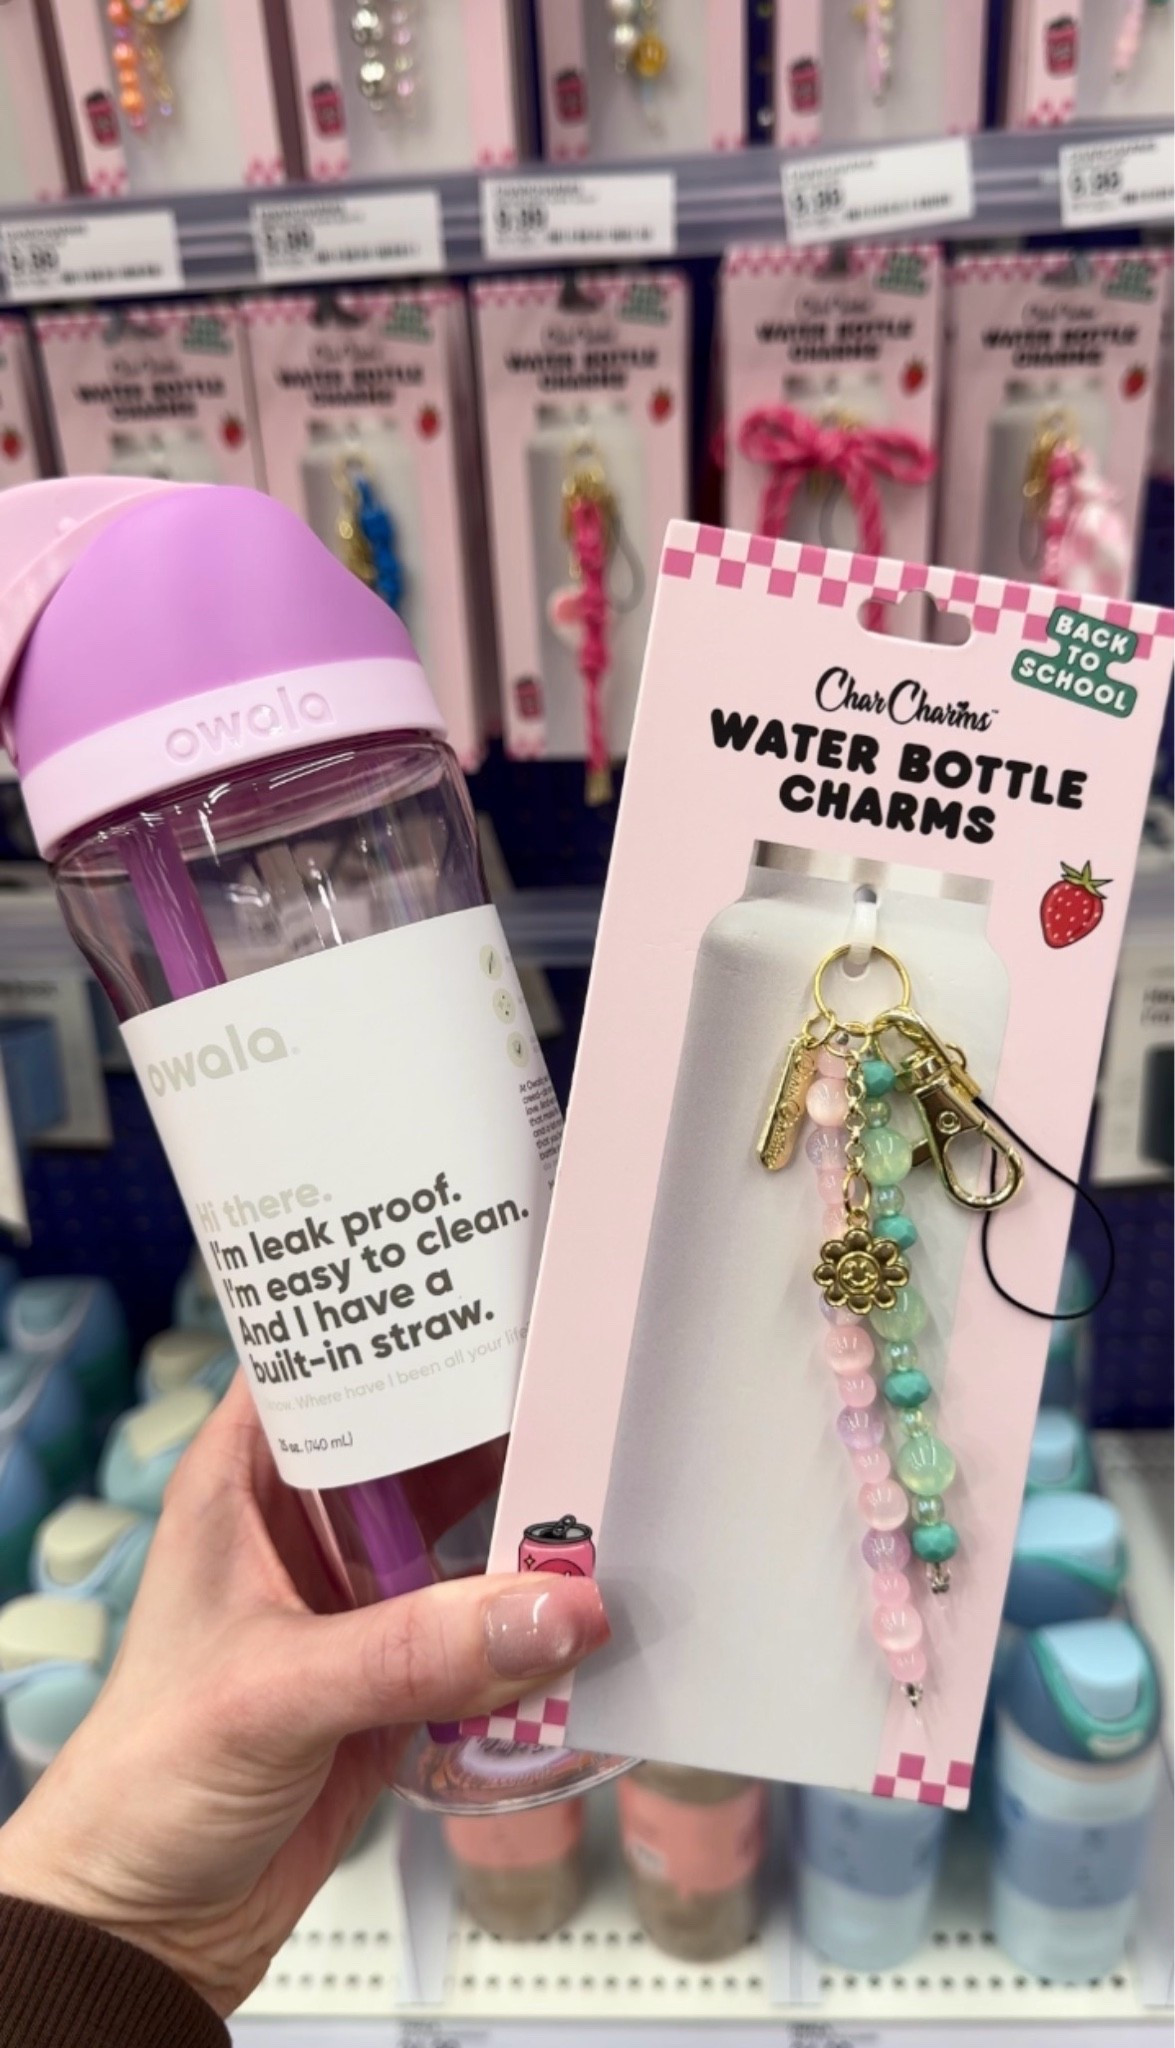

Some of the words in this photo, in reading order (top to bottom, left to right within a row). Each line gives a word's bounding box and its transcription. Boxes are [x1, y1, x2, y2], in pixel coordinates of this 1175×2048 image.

[1053, 613, 1130, 657] BACK
[1066, 643, 1100, 672] TO
[1018, 656, 1128, 712] SCHOOL
[165, 686, 335, 760] owala
[710, 708, 880, 776] WATER
[898, 742, 1088, 810] BOTTLE
[778, 774, 996, 844] CHARMS
[195, 1199, 221, 1234] Hi
[223, 1182, 333, 1230] there.
[209, 1240, 248, 1273] I'm
[253, 1216, 333, 1264] leak
[341, 1172, 462, 1246] proof.
[222, 1277, 262, 1310] I'm
[267, 1258, 351, 1303] easy
[360, 1238, 406, 1274] to
[417, 1198, 530, 1256] clean.
[240, 1308, 290, 1347] And
[293, 1305, 309, 1337] I
[317, 1280, 415, 1332] have
[425, 1268, 454, 1297] a
[250, 1338, 363, 1385] built-in
[372, 1297, 495, 1359] straw.
[295, 1390, 342, 1410] Where
[344, 1379, 385, 1400] have
[387, 1369, 394, 1382] I
[396, 1360, 442, 1385] been
[445, 1349, 465, 1370] all
[467, 1338, 503, 1364] your
